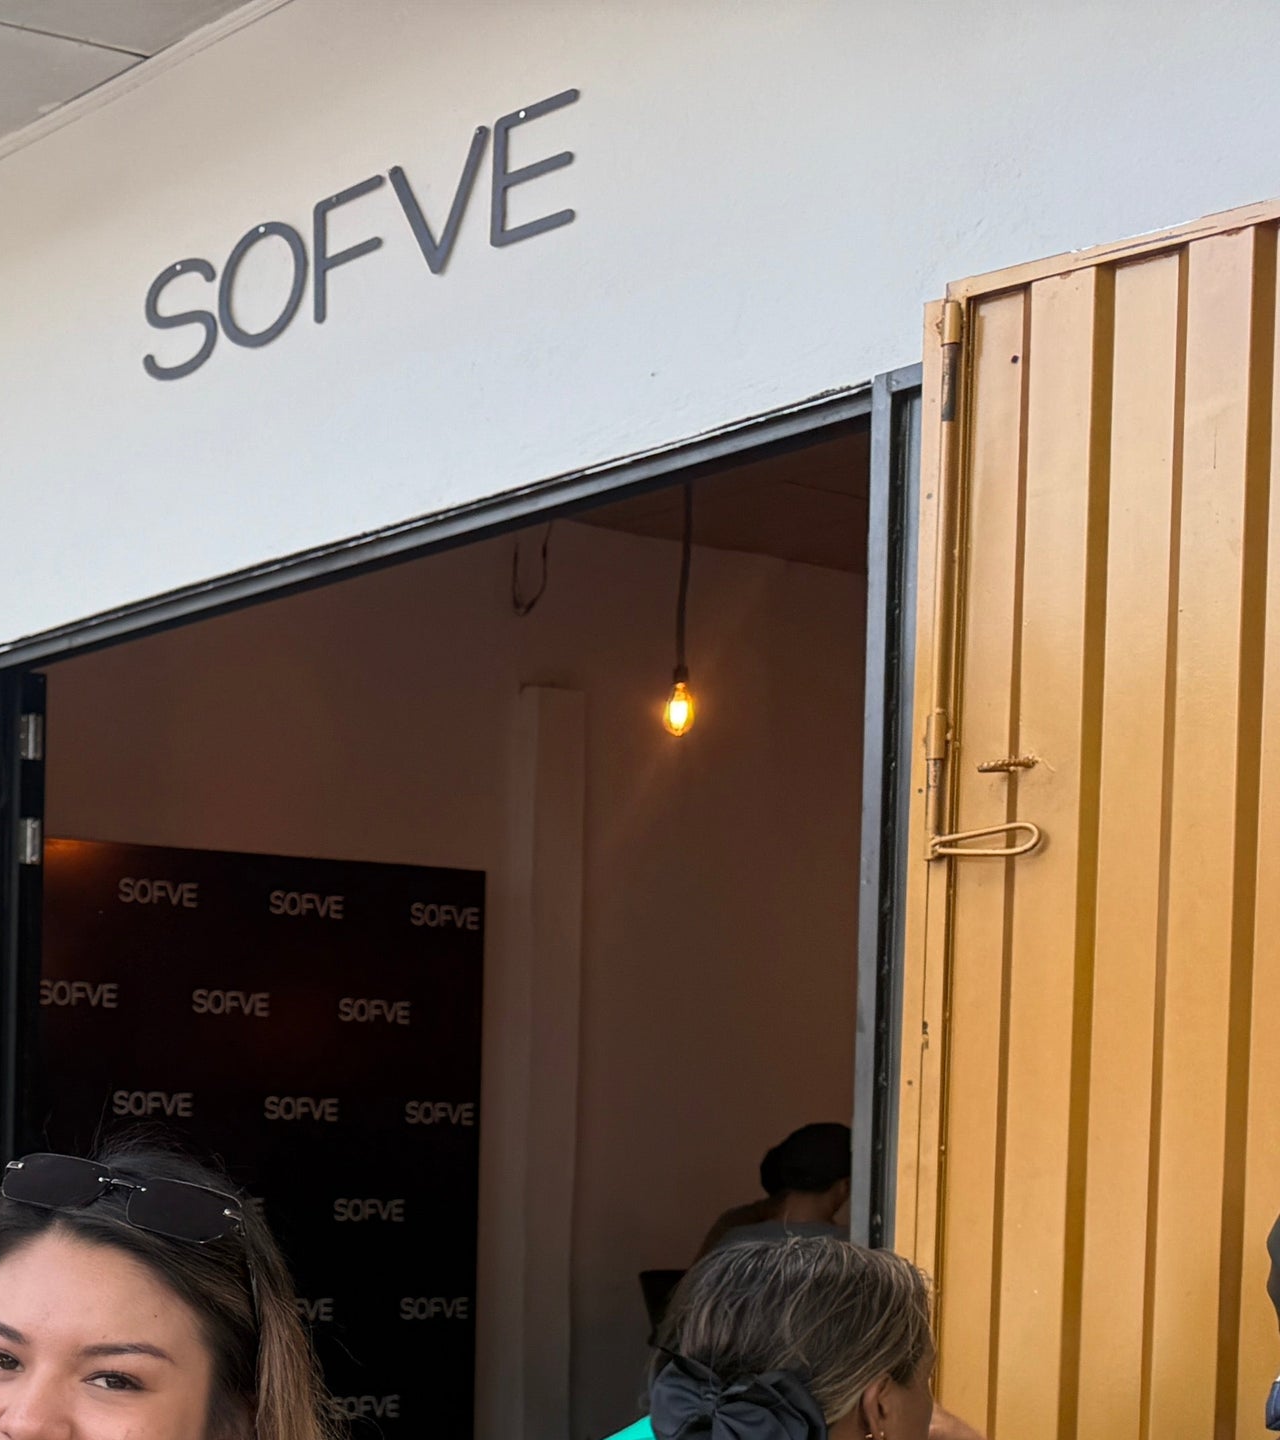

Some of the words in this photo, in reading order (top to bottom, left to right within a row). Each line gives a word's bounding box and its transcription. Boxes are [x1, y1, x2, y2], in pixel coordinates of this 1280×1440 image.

[143, 88, 580, 381] SOFVE
[118, 877, 199, 908] SOFVE
[269, 890, 344, 919] SOFVE
[410, 902, 480, 930] SOFVE
[39, 979, 119, 1008] SOFVE
[192, 989, 270, 1017] SOFVE
[339, 998, 411, 1025] SOFVE
[112, 1090, 193, 1117] SOFVE
[264, 1096, 338, 1121] SOFVE
[405, 1101, 474, 1126] SOFVE
[333, 1198, 405, 1222] SOFVE
[400, 1297, 469, 1320] SOFVE
